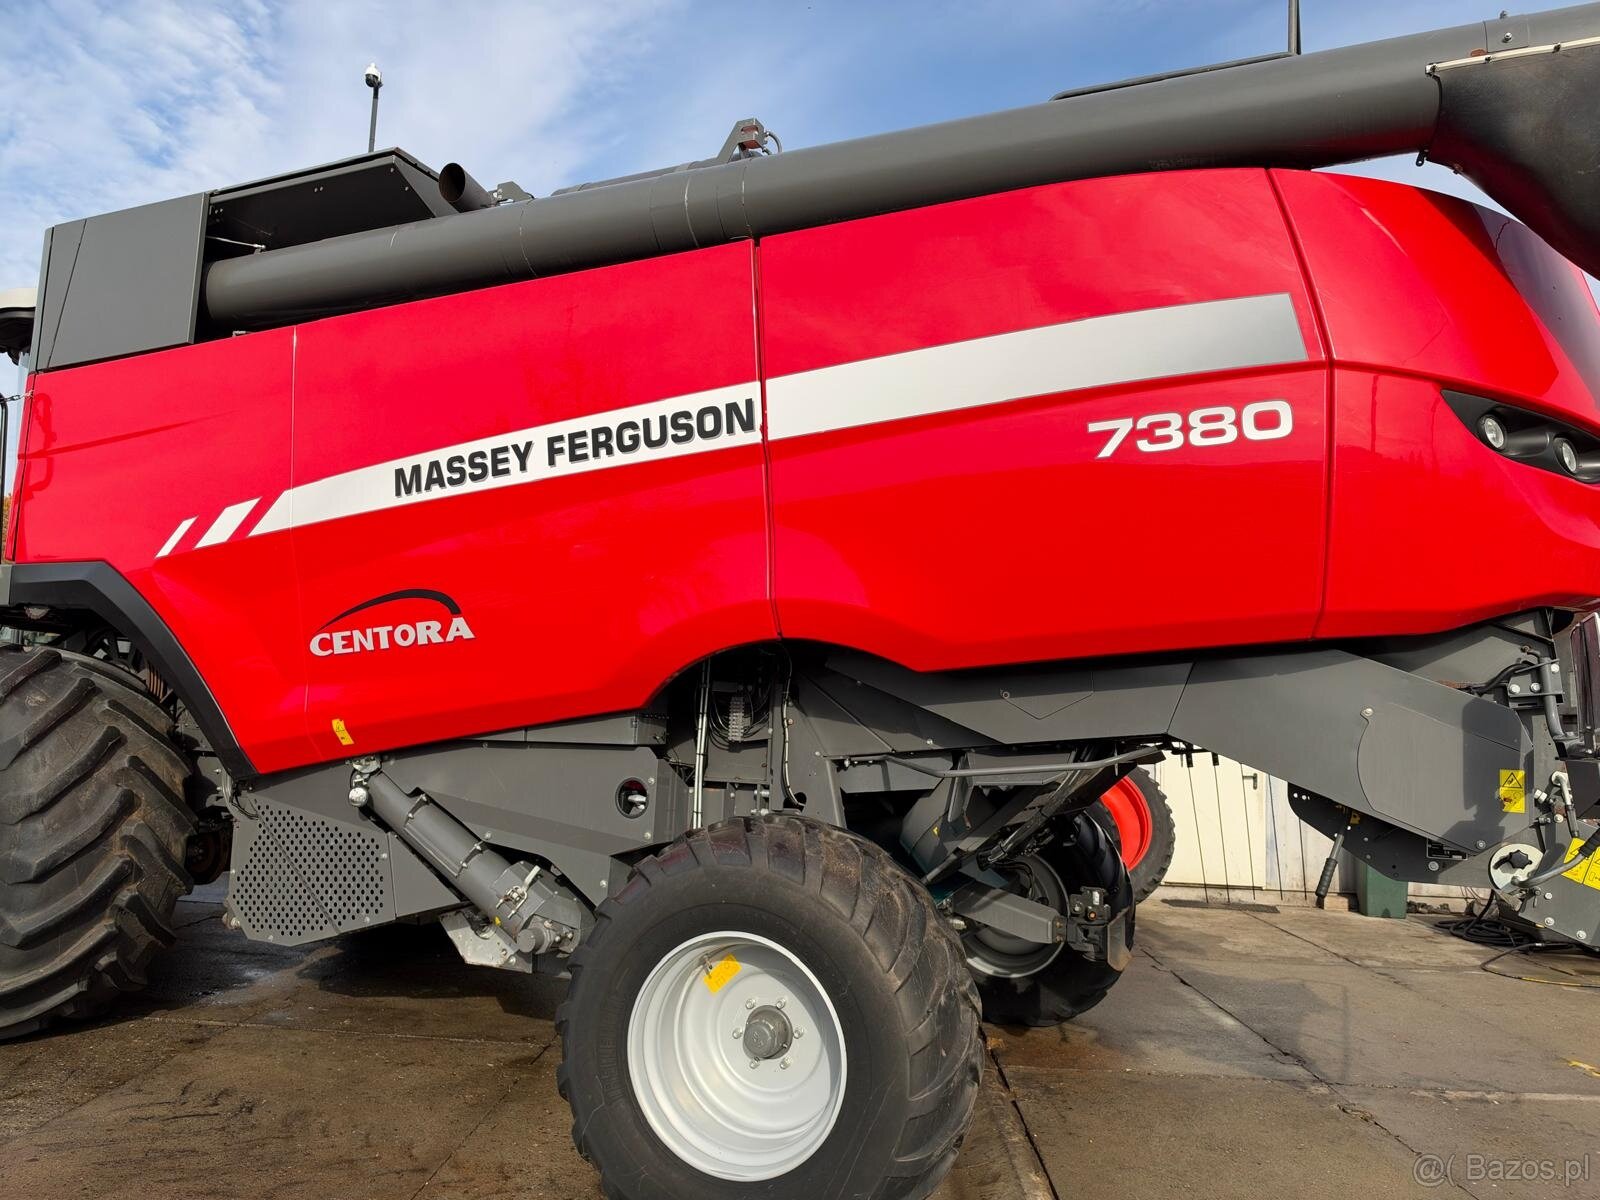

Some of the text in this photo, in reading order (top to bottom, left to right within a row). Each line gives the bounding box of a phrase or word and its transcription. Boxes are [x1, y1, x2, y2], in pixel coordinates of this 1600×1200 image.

[394, 398, 755, 498] MASSEY FERGUSON
[1087, 400, 1294, 458] 7380
[309, 616, 476, 657] CENTORA
